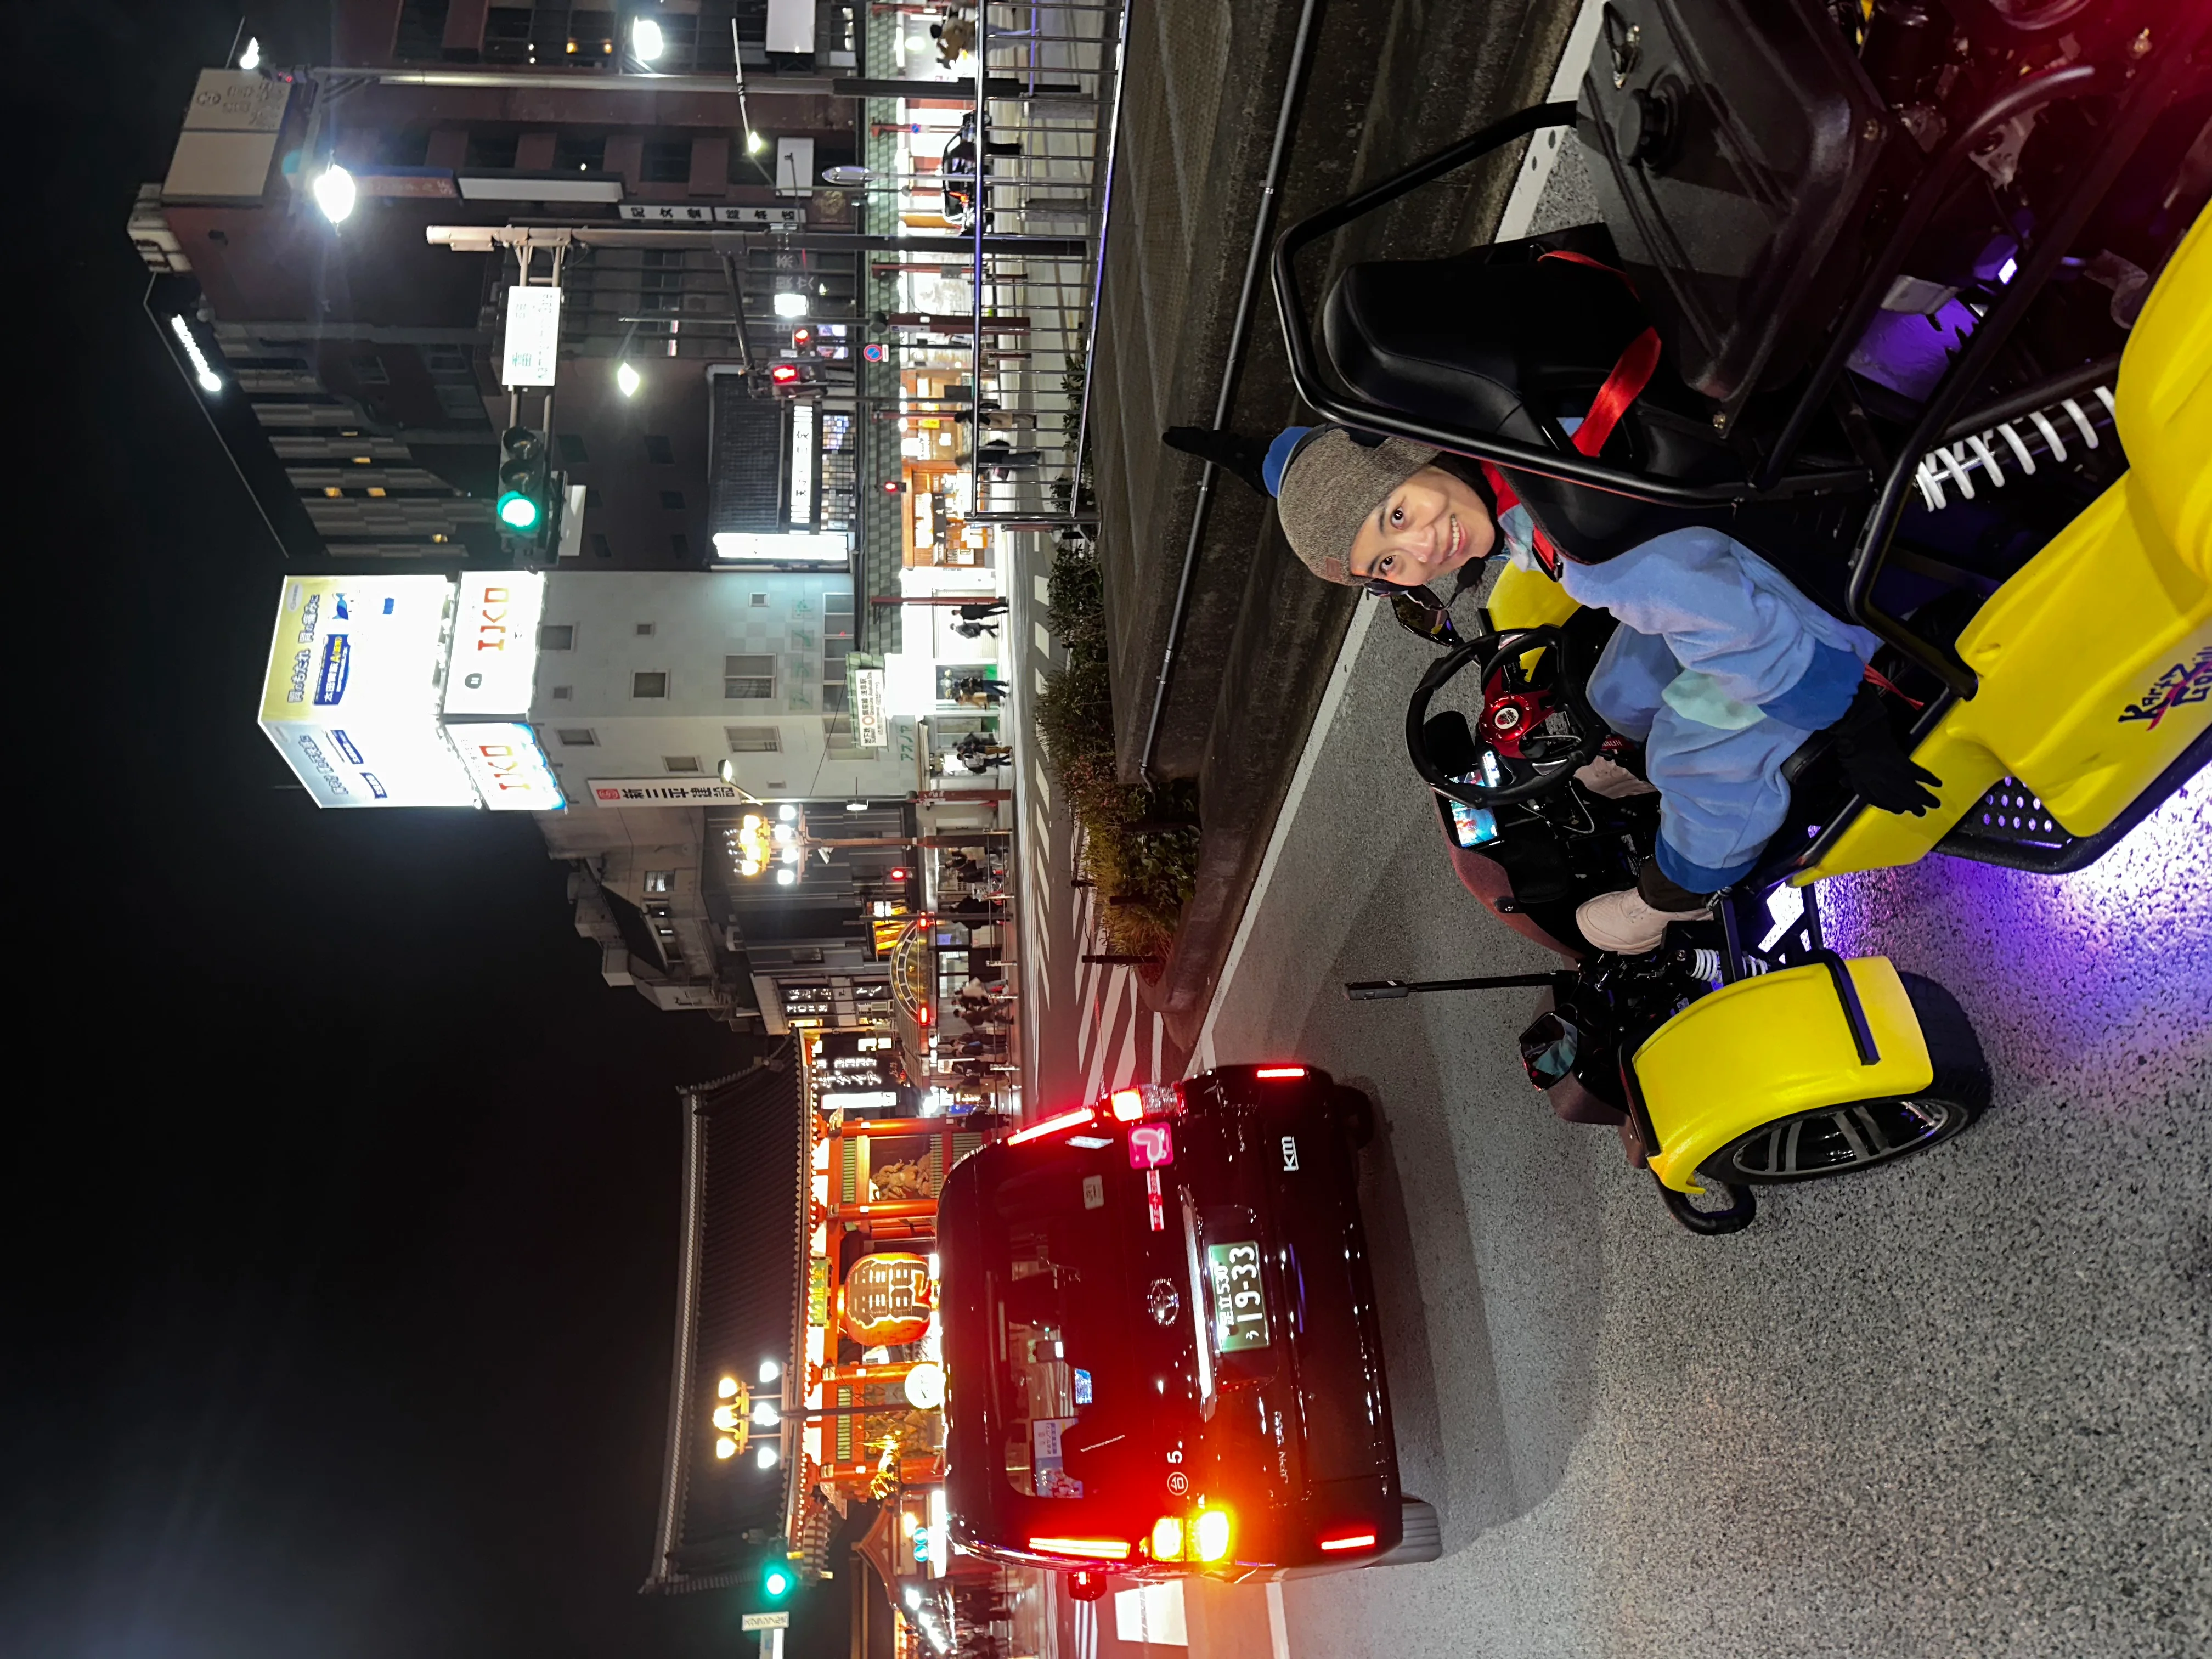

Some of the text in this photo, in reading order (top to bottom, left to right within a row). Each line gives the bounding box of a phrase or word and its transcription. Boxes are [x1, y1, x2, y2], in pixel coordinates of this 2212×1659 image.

[287, 594, 320, 703] 胃のもたれ 胃の痛みに
[900, 725, 913, 761] アオノヤ
[621, 787, 735, 799] 新三平建設
[1281, 1136, 1297, 1171] km
[1214, 1266, 1234, 1325] 足立 530
[1229, 1246, 1263, 1340] う 19-33
[1167, 1451, 1183, 1464] 5
